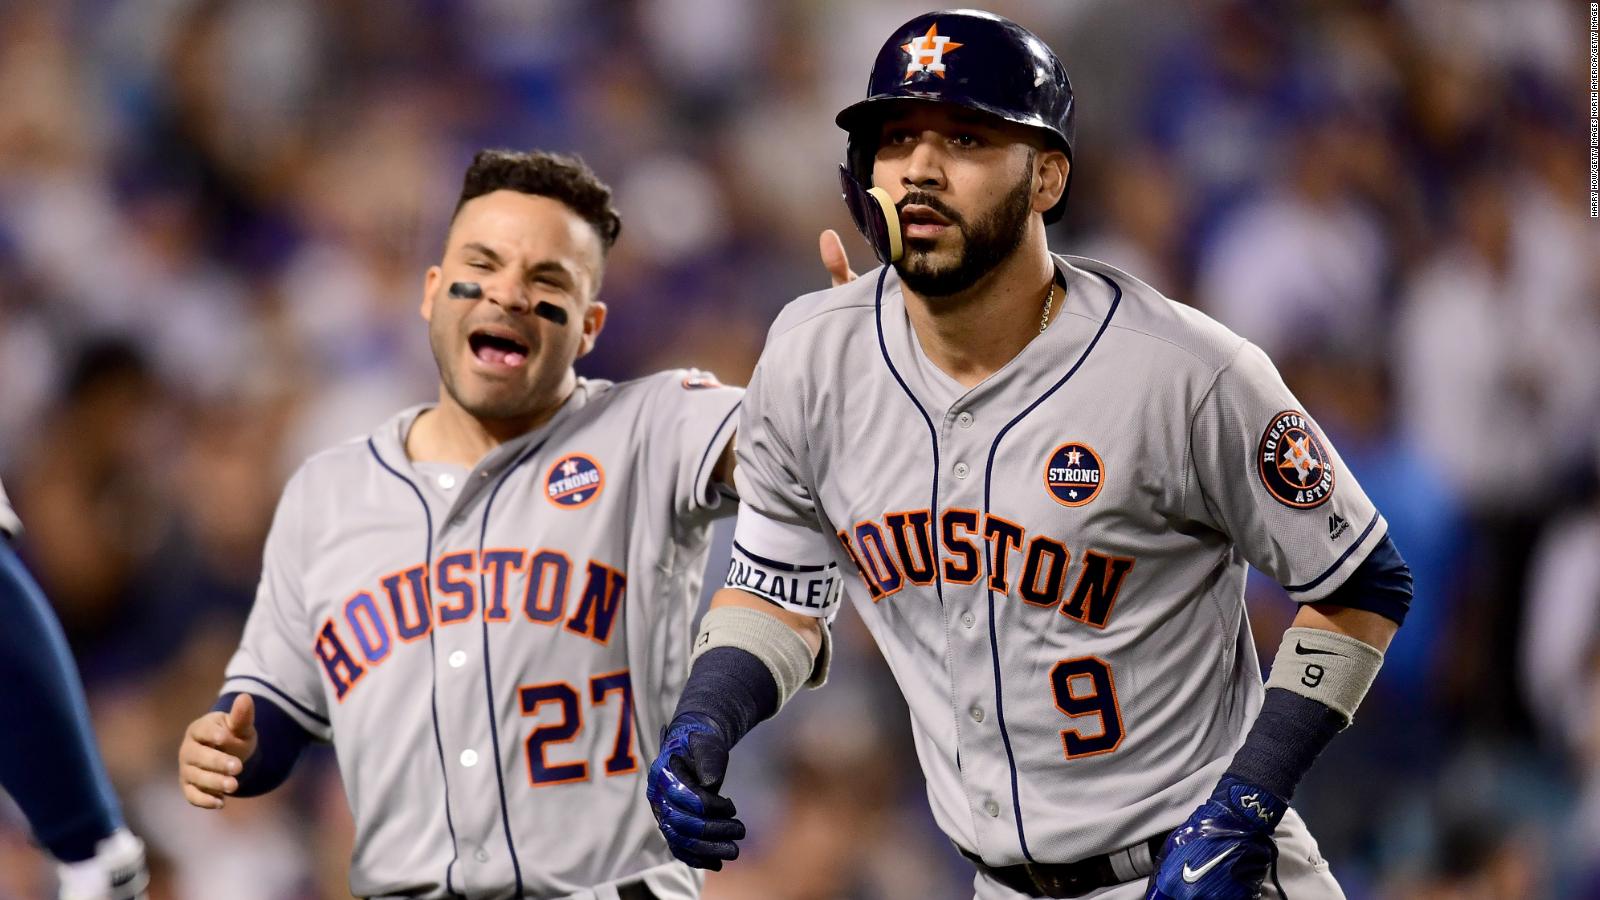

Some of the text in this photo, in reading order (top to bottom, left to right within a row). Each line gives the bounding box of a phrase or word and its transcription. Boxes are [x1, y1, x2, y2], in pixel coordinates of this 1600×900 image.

[907, 36, 950, 73] H
[1264, 415, 1307, 463] HOUSTON
[549, 469, 599, 497] STRONG
[1049, 467, 1099, 483] STRONG
[1295, 462, 1332, 503] ASTROS
[724, 557, 834, 609] ONZALEZ
[313, 547, 627, 704] HOUSTON
[1301, 664, 1325, 688] 9
[517, 670, 638, 788] 27
[1048, 656, 1125, 760] 9
